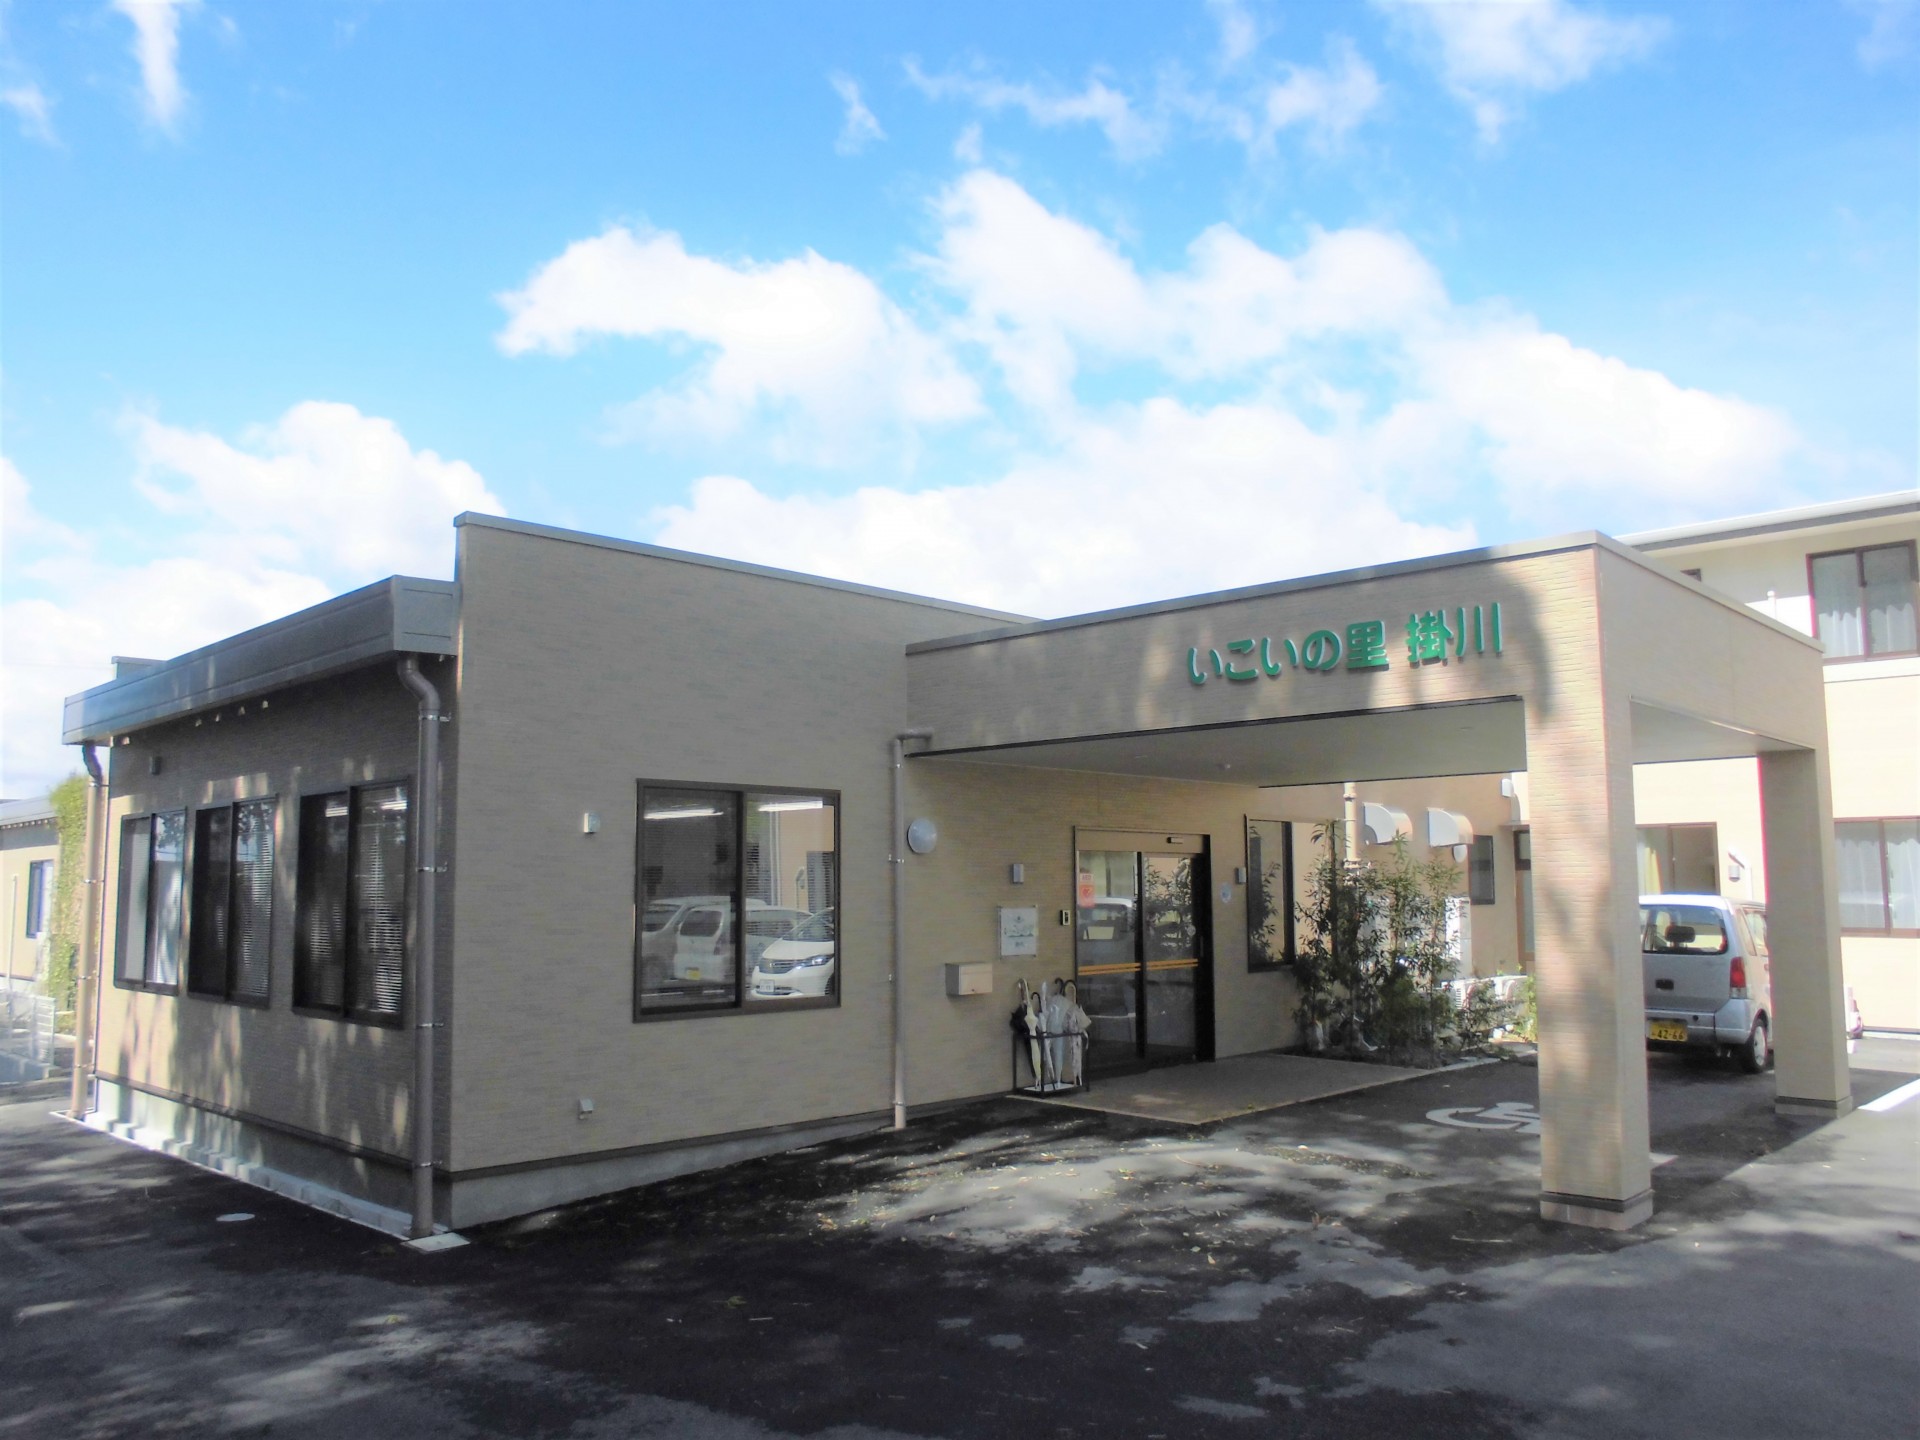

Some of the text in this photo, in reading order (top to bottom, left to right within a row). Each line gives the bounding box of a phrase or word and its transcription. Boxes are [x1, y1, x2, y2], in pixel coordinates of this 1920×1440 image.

[1187, 602, 1503, 684] いこいの里 掛川
